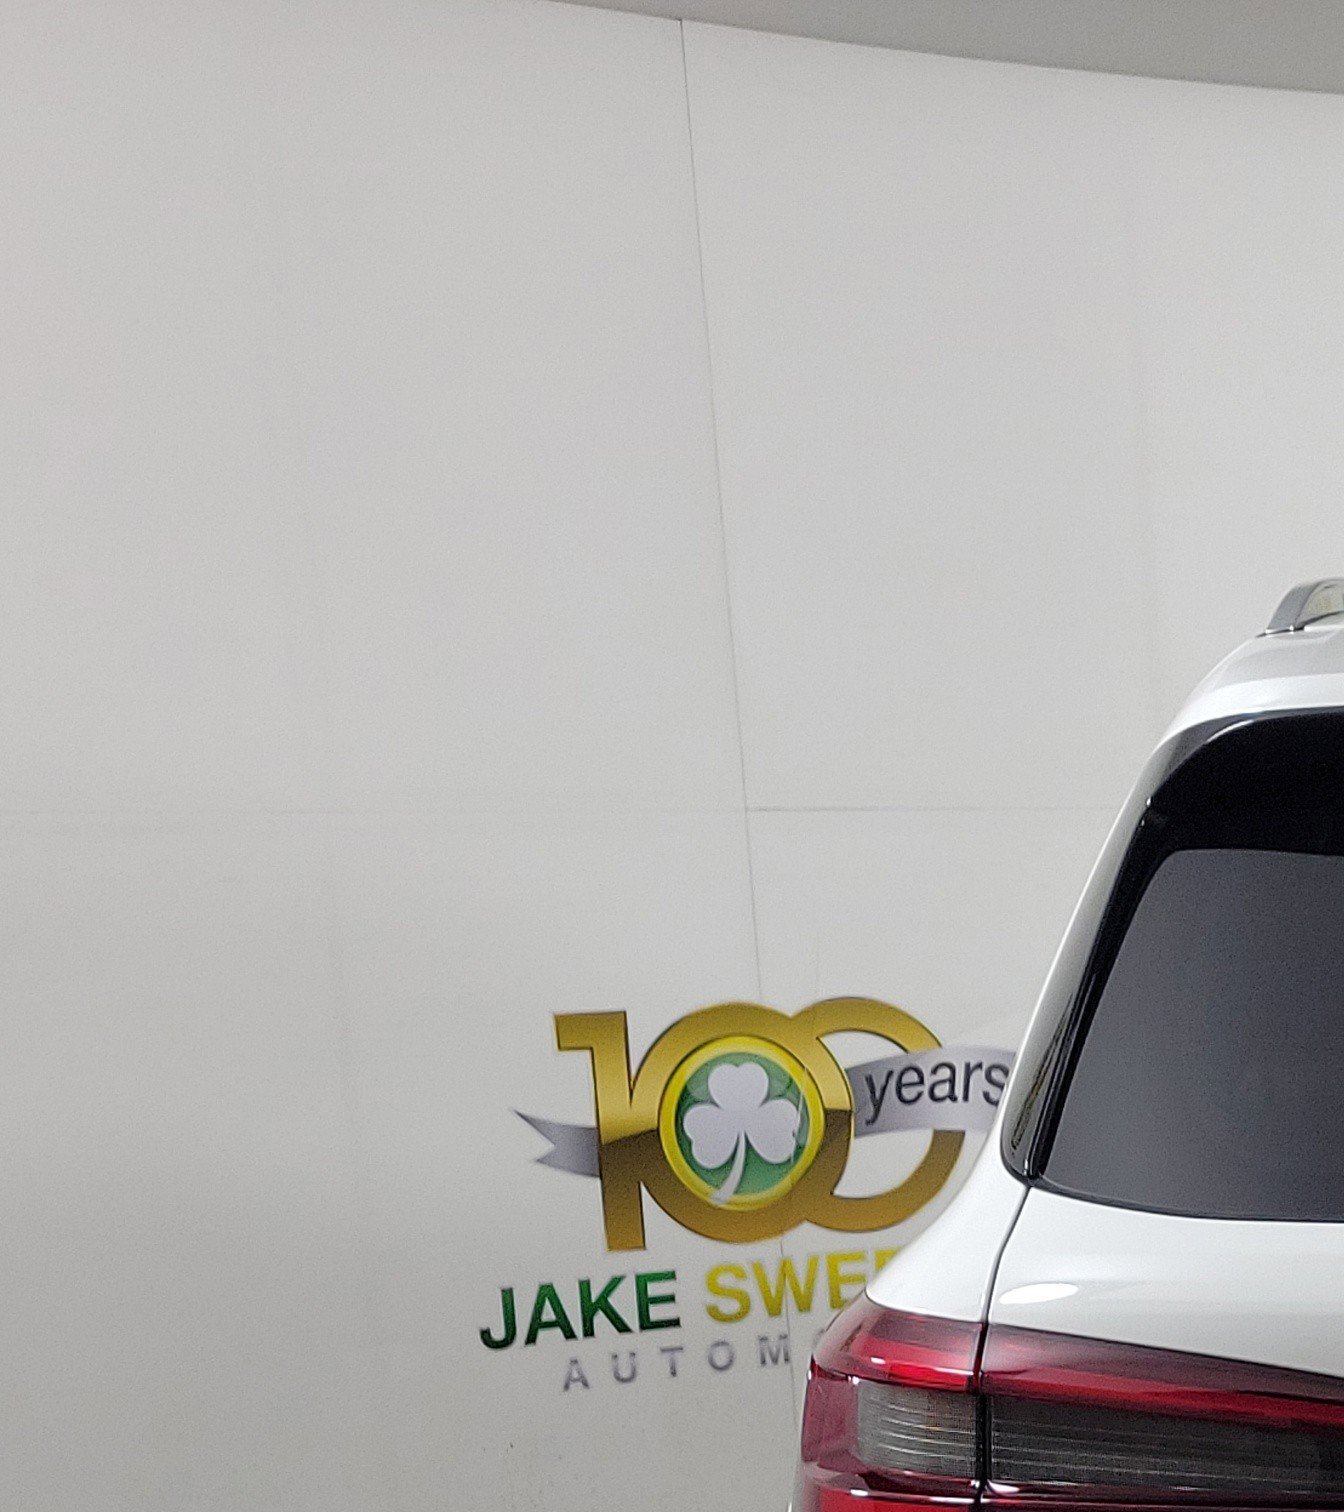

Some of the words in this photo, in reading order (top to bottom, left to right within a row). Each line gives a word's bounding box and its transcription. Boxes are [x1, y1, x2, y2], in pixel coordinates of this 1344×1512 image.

[553, 997, 966, 1252] 100
[864, 1061, 1009, 1126] years
[479, 1270, 681, 1350] JAKE
[705, 1248, 900, 1325] SWE
[563, 1328, 825, 1392] AUTOM
